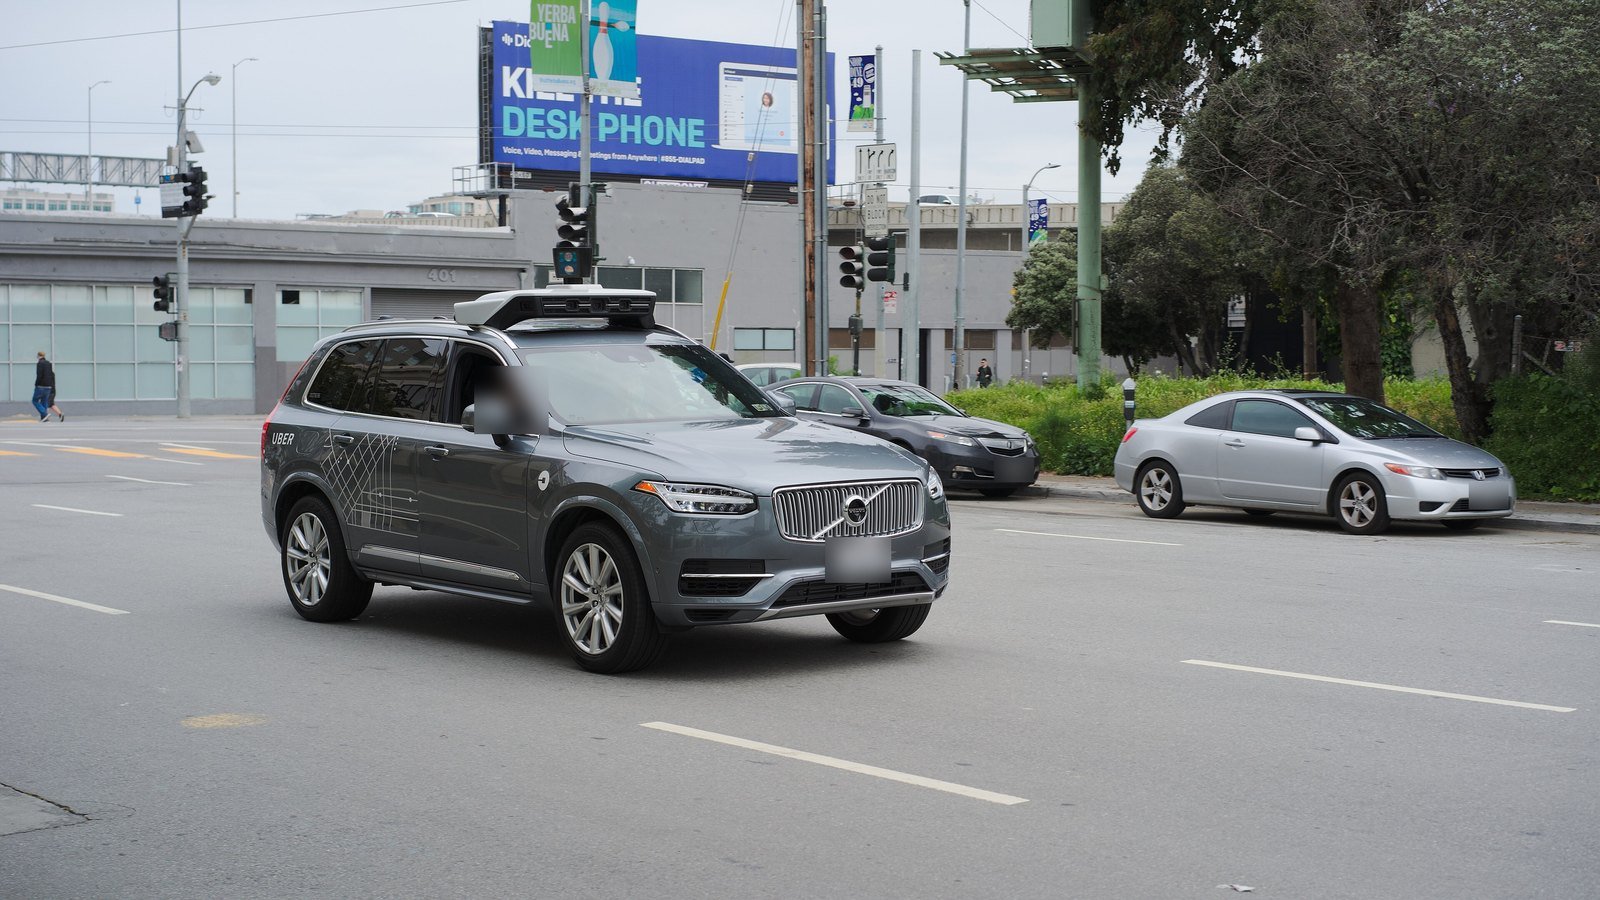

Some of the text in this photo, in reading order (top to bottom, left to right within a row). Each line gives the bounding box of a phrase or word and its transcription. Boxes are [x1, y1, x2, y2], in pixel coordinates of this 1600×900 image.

[537, 3, 576, 24] YERBA
[529, 21, 570, 48] BUENA
[598, 112, 705, 148] PHONE
[502, 146, 523, 156] Voice,
[523, 147, 544, 157] Video,
[544, 149, 576, 159] Messaging
[612, 152, 627, 160] from
[628, 153, 658, 163] Anywhere
[661, 155, 706, 165] #855-DIALPAD
[428, 268, 456, 282] 401
[272, 432, 295, 446] UBER
